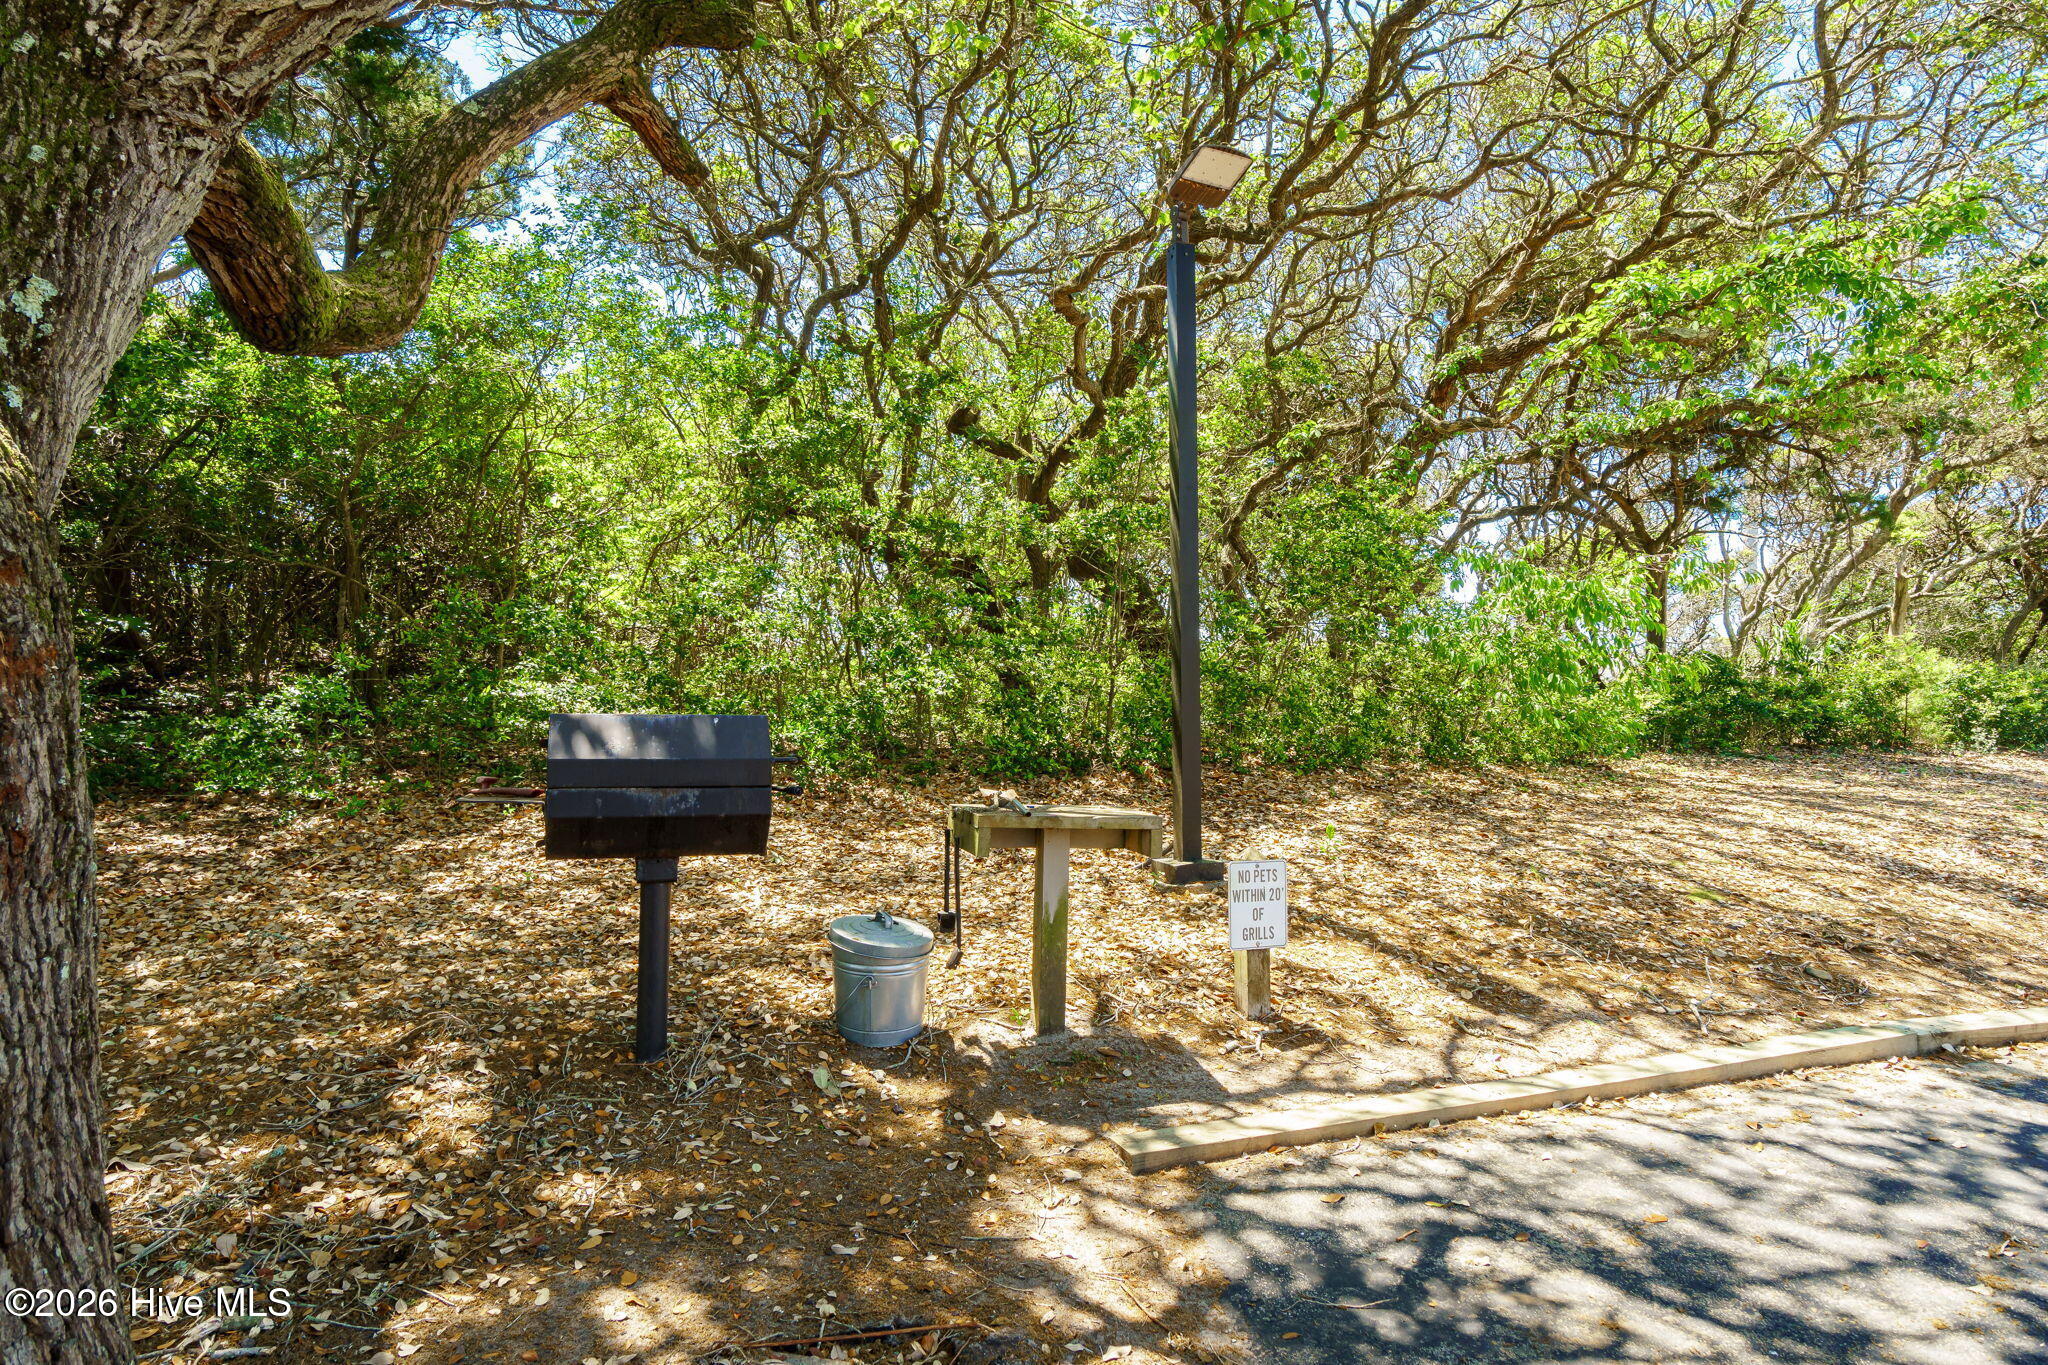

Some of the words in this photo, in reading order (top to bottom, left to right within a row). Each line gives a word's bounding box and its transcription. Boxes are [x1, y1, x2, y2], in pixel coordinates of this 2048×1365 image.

[1238, 870, 1251, 883] NO
[1253, 869, 1278, 883] PETS
[1232, 888, 1266, 903] WITHIN
[1269, 887, 1284, 901] 20'
[1252, 907, 1264, 921] OF
[1242, 926, 1275, 941] GRILLS
